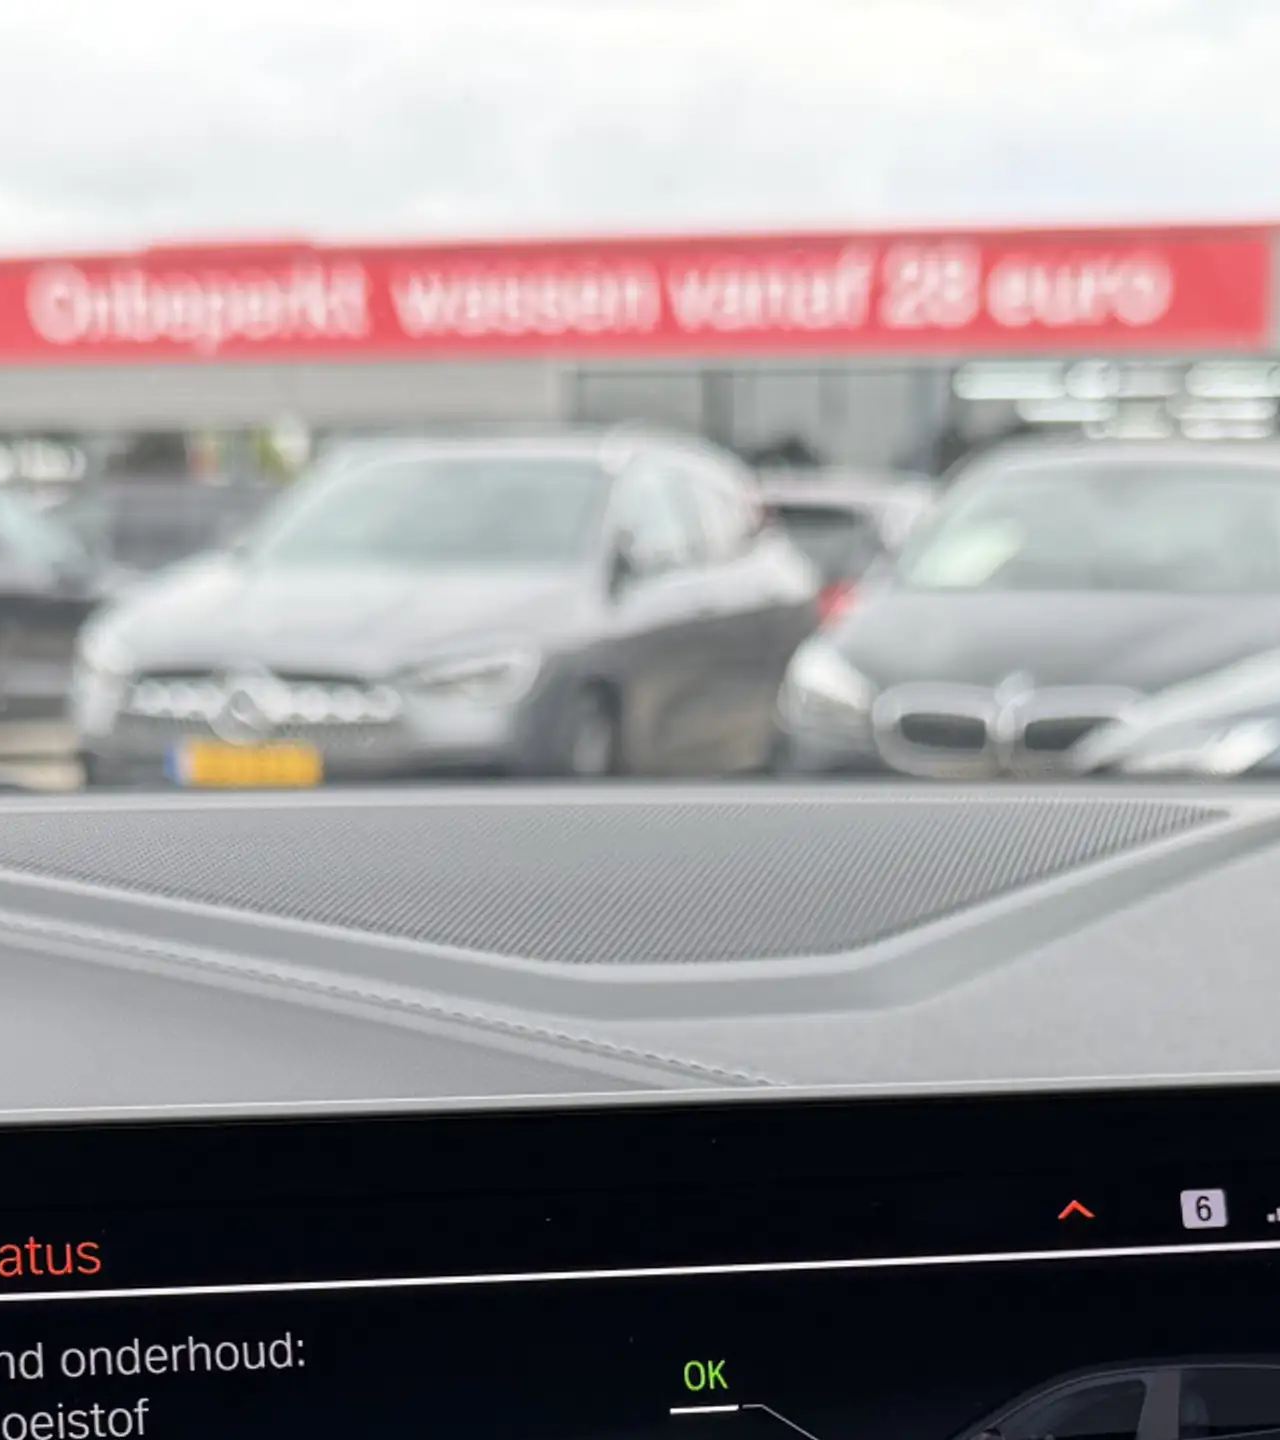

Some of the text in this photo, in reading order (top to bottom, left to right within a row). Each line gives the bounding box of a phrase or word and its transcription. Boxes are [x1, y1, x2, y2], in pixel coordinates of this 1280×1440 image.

[668, 246, 875, 332] vanaf
[987, 254, 1173, 327] euro
[1195, 1195, 1212, 1221] 6
[60, 1332, 306, 1377] onderhoud:
[683, 1360, 729, 1391] OK
